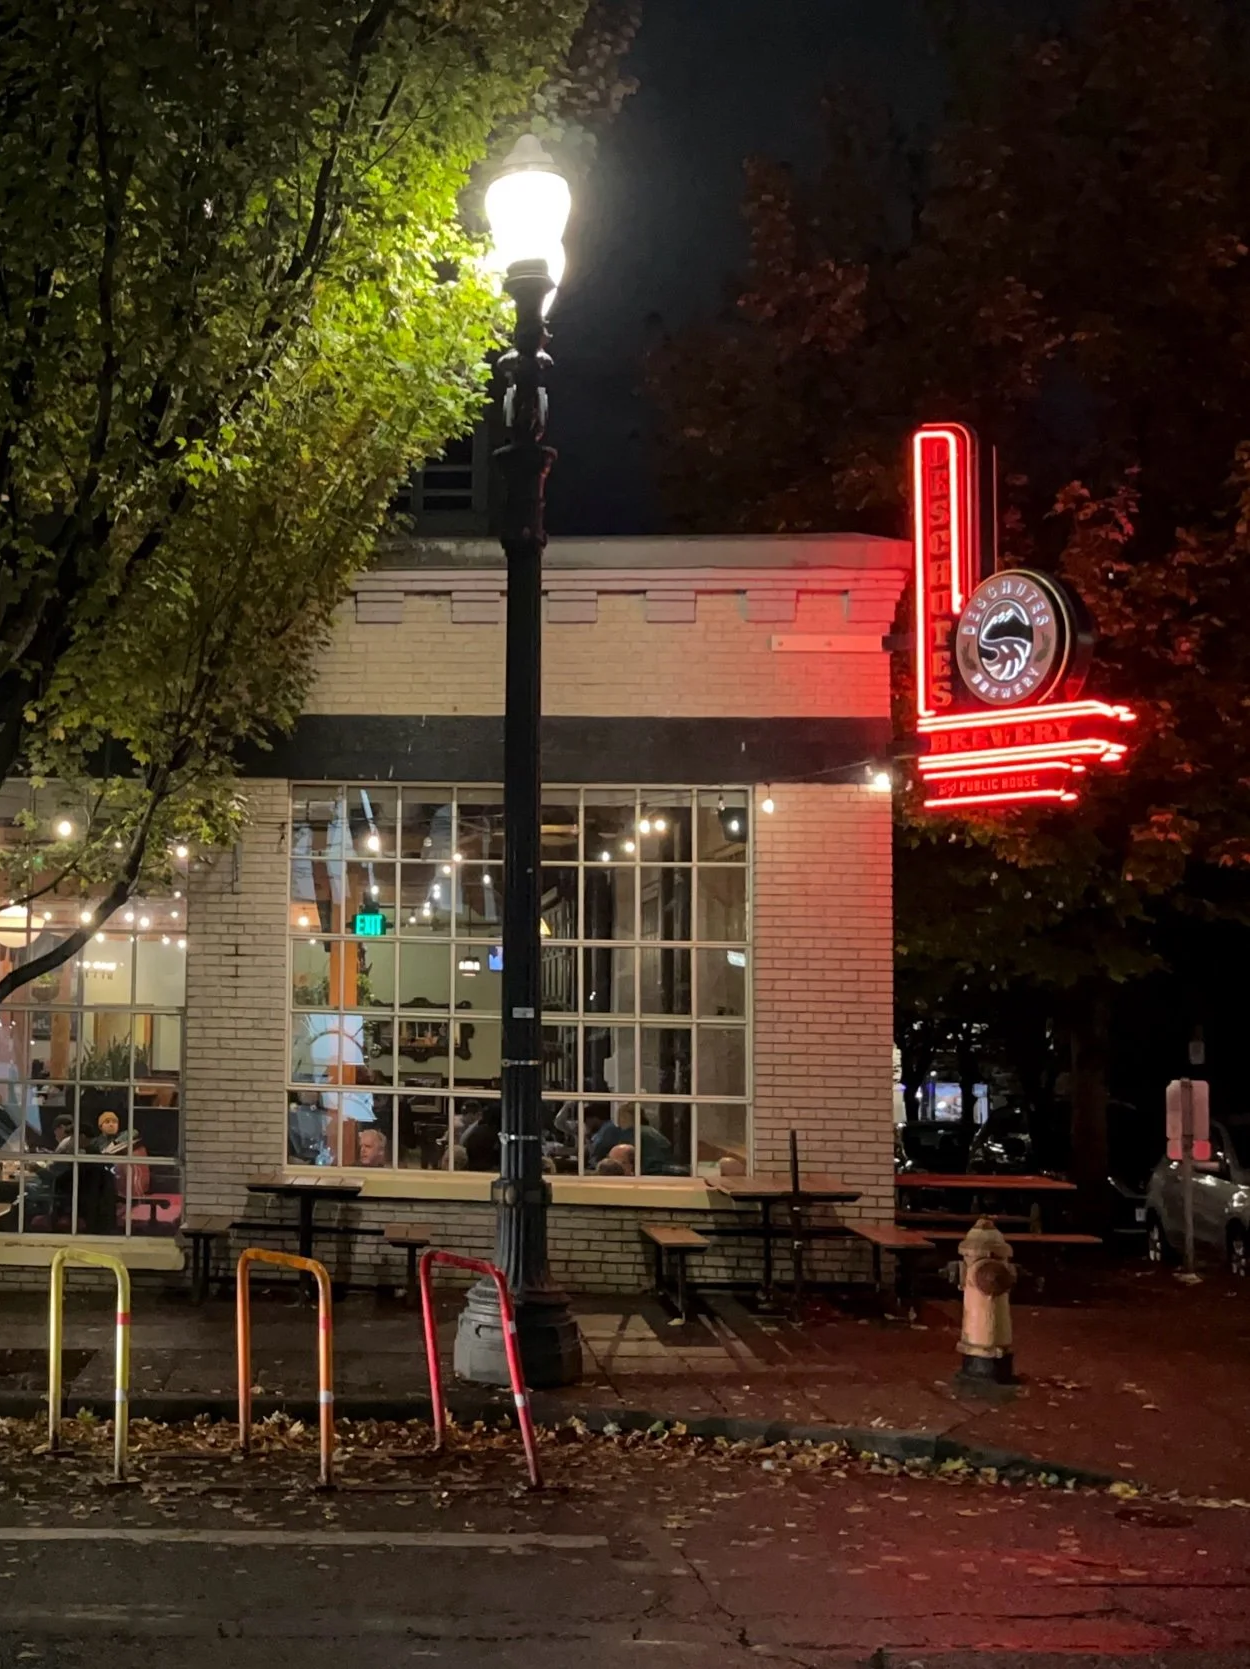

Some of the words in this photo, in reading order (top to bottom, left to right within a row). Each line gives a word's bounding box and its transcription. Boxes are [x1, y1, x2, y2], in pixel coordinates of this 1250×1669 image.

[929, 442, 952, 706] DESCHUTES
[961, 581, 1049, 636] DESCHUTES
[971, 667, 1039, 698] BREWERY
[930, 721, 1072, 753] BREWERY
[959, 778, 999, 793] PUBLIC
[1001, 775, 1039, 789] HOUSE
[356, 914, 382, 936] EXIT
